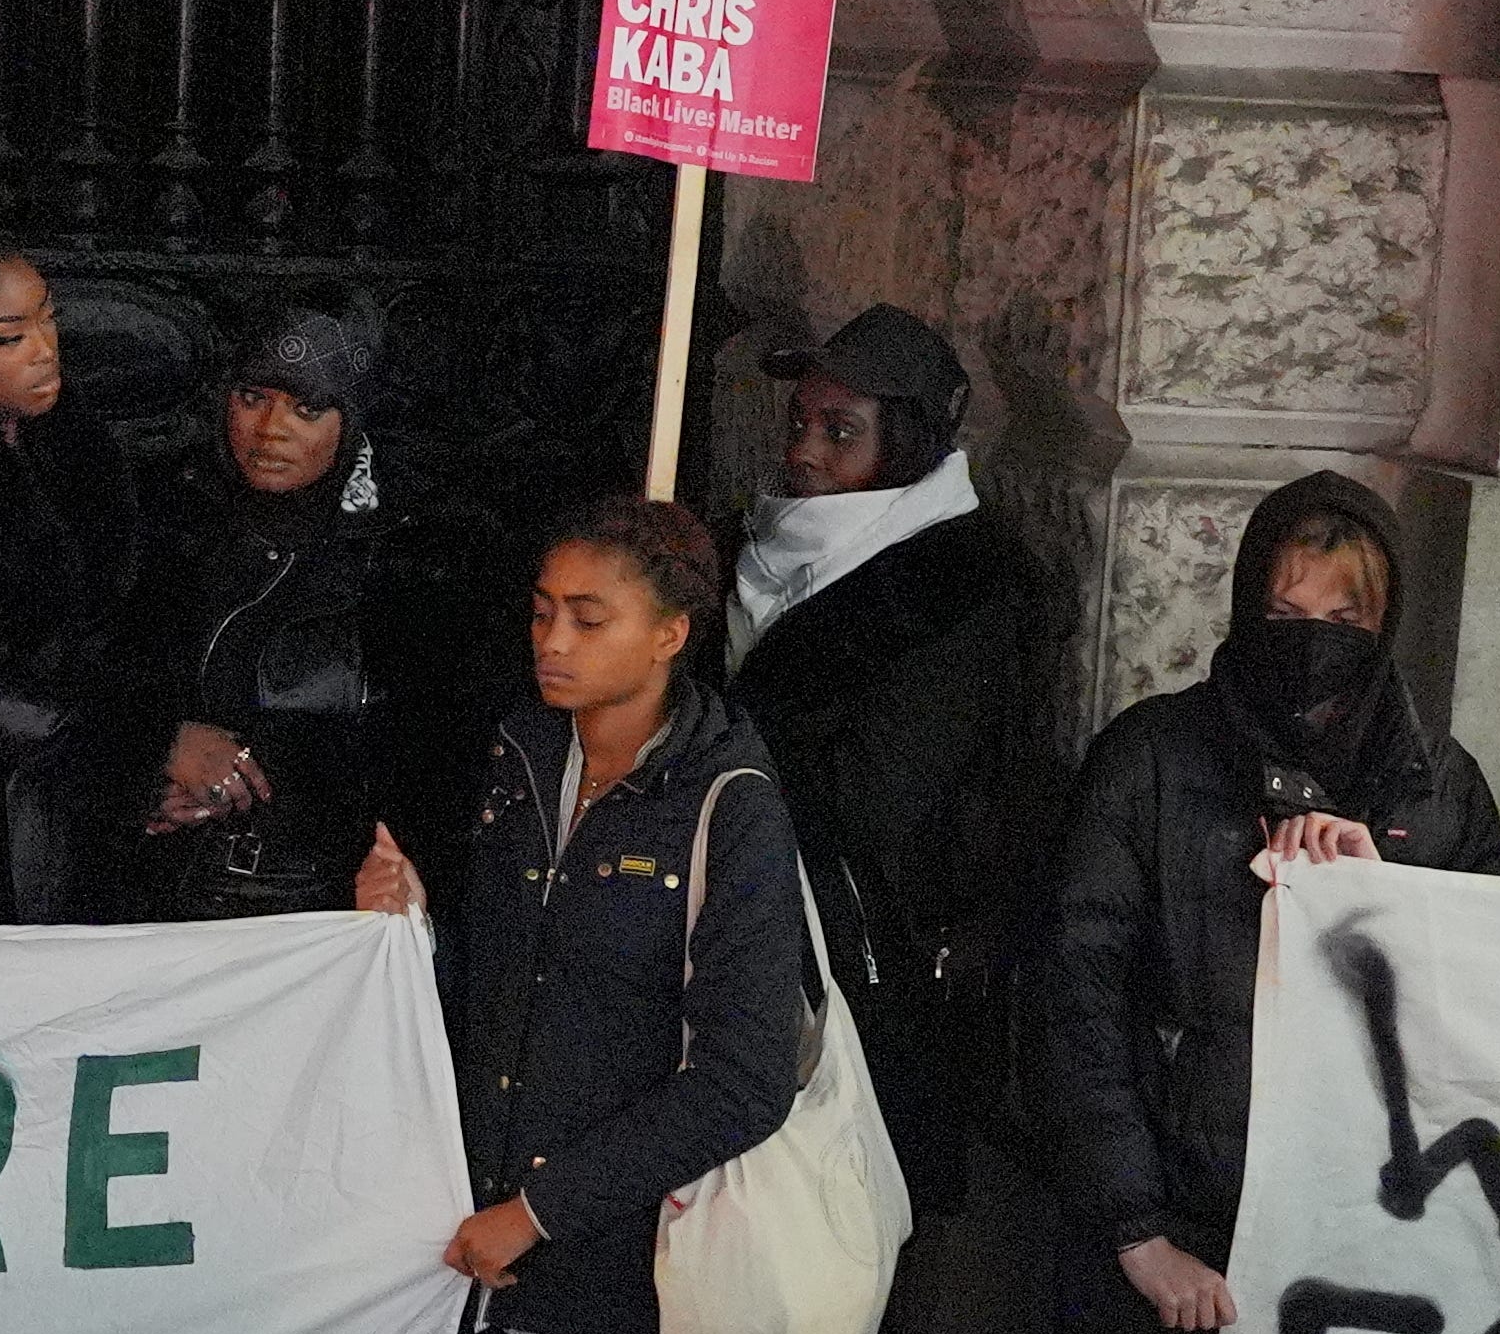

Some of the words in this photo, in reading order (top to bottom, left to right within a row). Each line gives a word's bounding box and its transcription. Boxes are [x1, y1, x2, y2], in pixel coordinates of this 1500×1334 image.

[609, 27, 734, 102] KABA
[606, 85, 659, 117] Black
[664, 97, 716, 128] Lives
[719, 108, 803, 141] Matter
